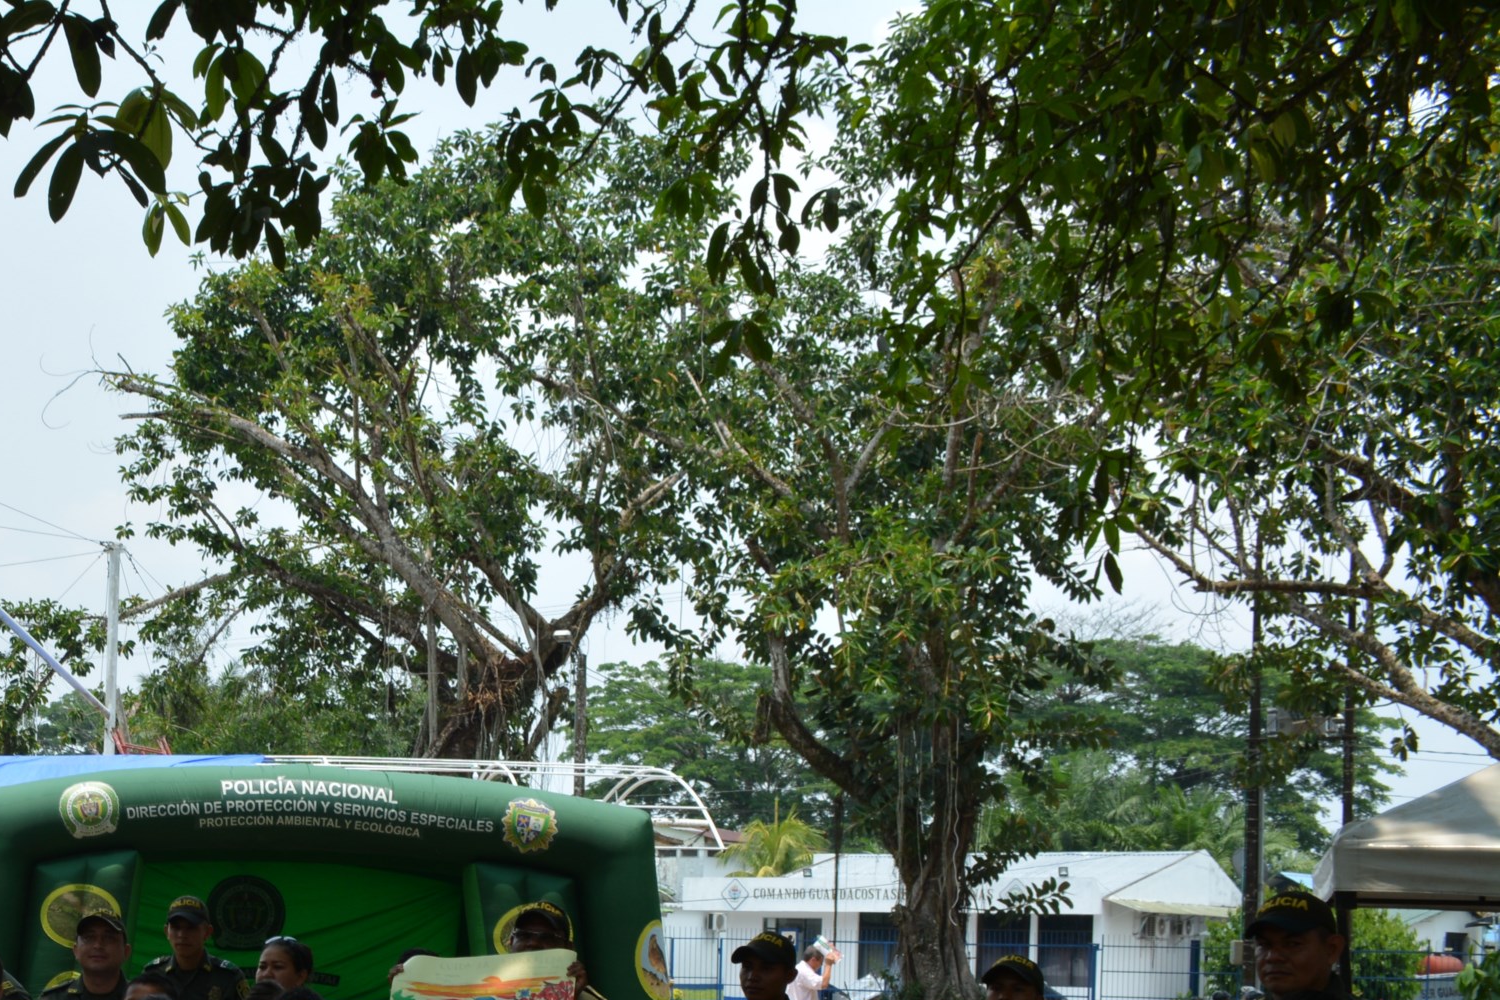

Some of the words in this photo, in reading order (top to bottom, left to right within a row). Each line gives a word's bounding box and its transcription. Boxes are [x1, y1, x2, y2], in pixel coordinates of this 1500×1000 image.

[221, 776, 297, 796] POLICÍA
[301, 780, 398, 805] NACIONAL
[126, 800, 200, 819] DIRECCIÓN
[204, 801, 222, 814] DE
[226, 797, 317, 813] PROTECCIÓN
[321, 801, 331, 813] Y
[333, 802, 407, 823] SERVICIOS
[410, 812, 495, 833] ESPECIALES
[199, 815, 274, 828] PROTECCIÓN
[276, 816, 341, 829] AMBIENTAL
[344, 820, 352, 830] Y
[354, 820, 421, 838] ECOLÓGICA
[753, 888, 806, 900] COMANDO
